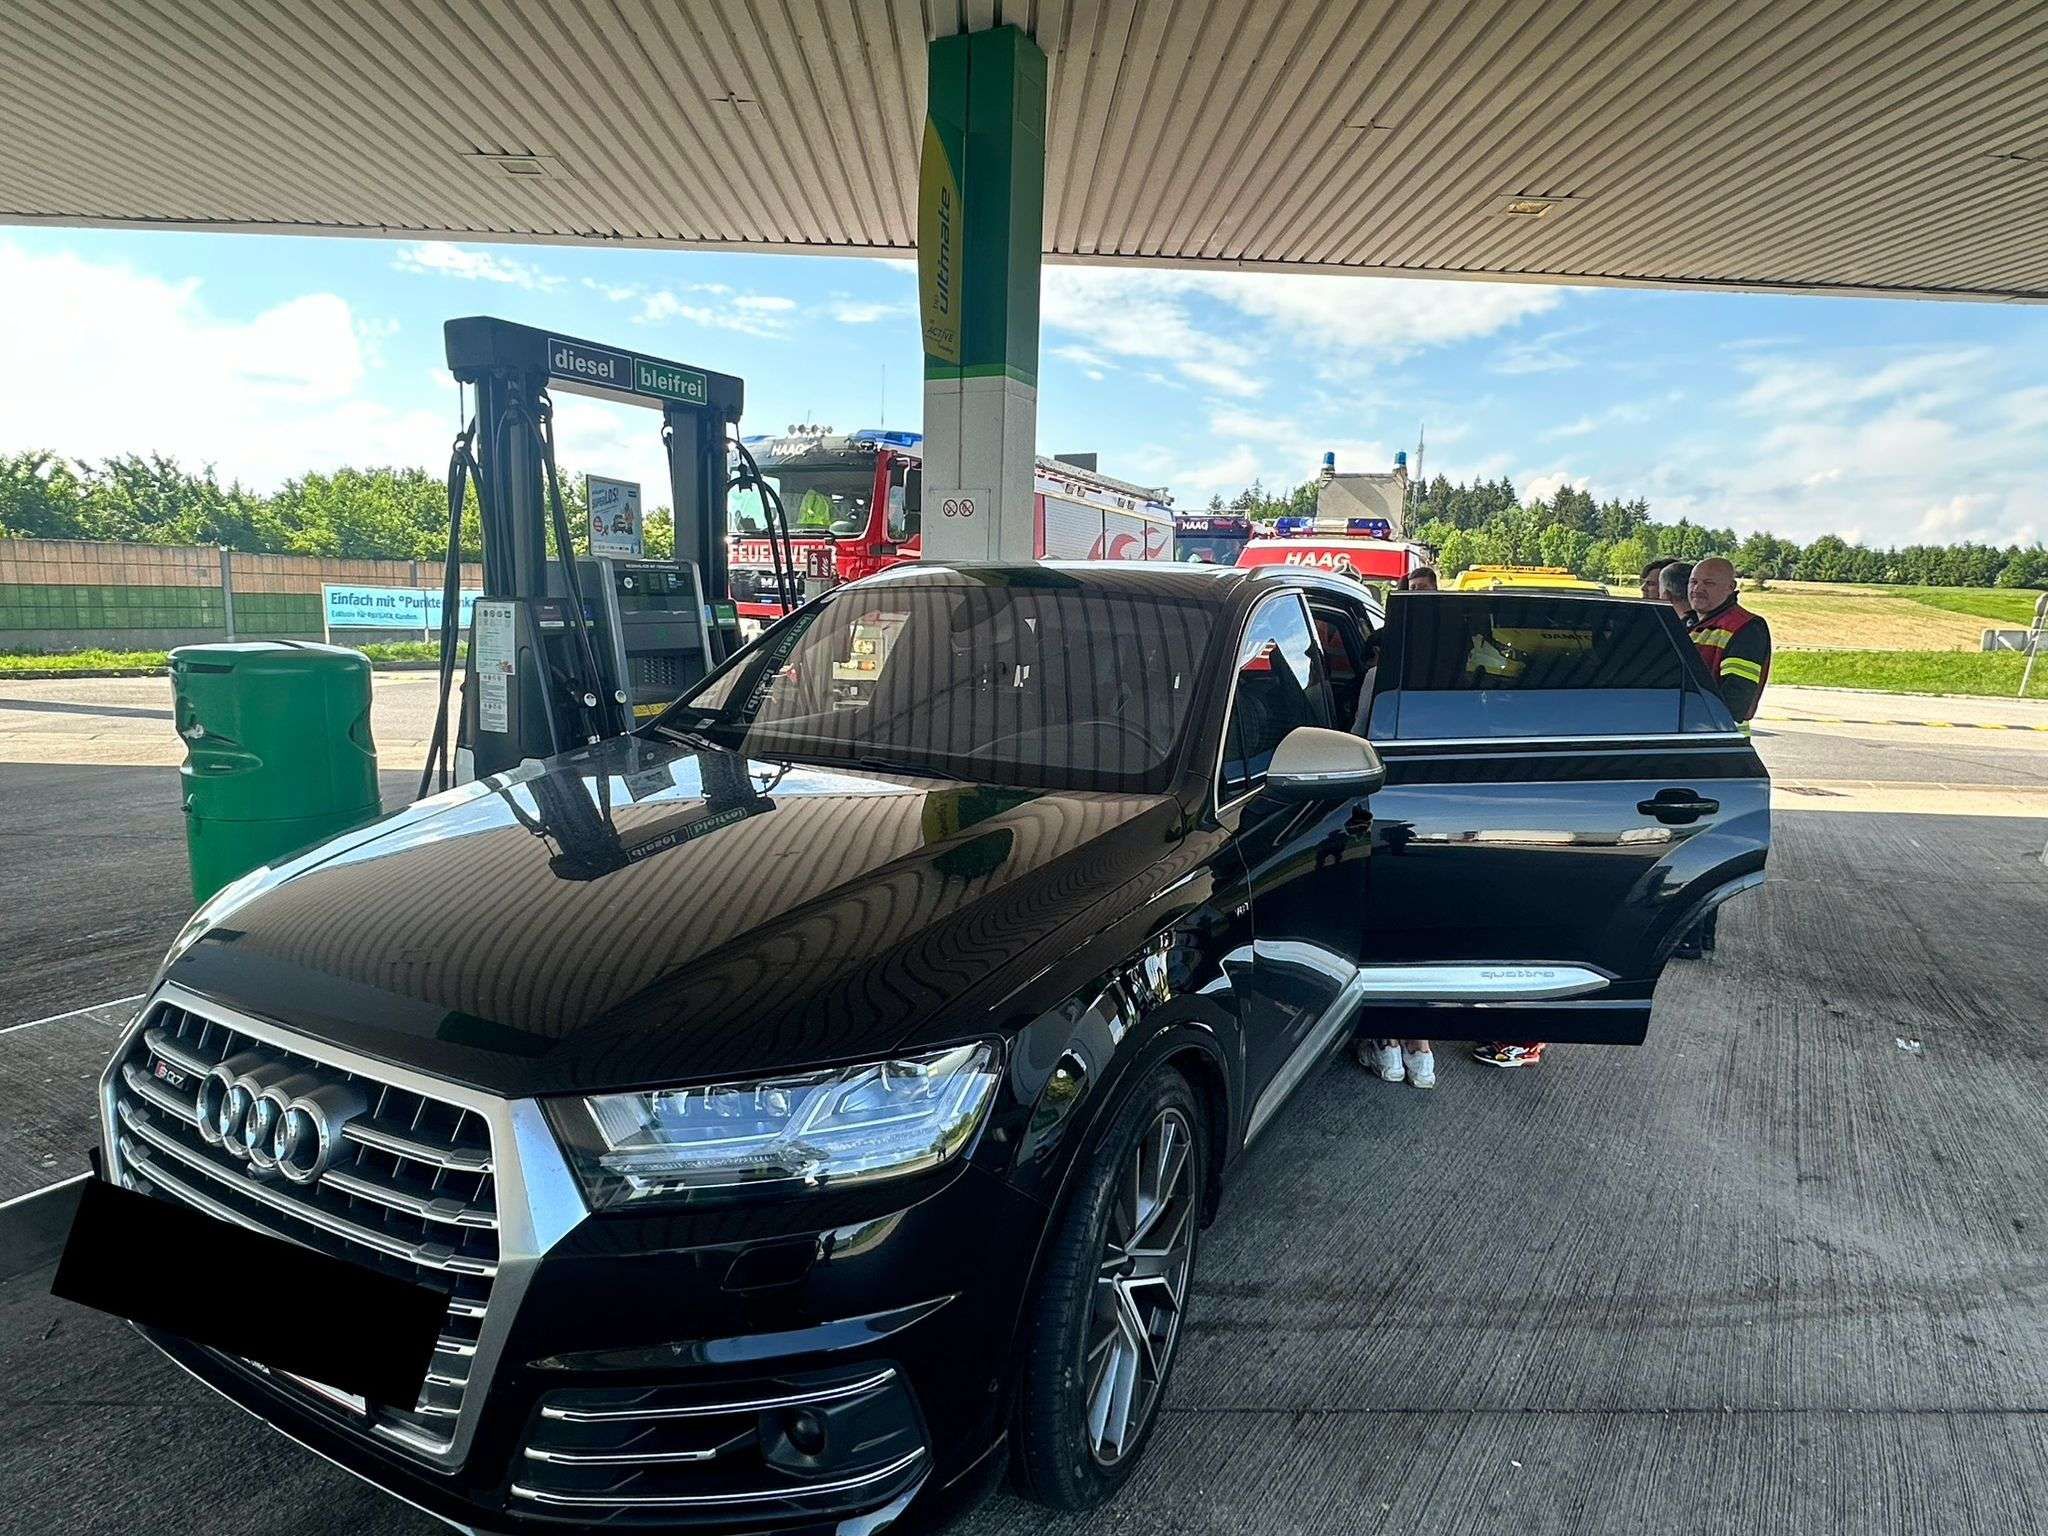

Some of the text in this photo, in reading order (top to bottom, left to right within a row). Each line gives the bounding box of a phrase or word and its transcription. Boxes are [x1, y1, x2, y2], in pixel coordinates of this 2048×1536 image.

[936, 186, 951, 315] ultimate
[555, 349, 614, 378] diesel
[641, 368, 702, 397] bleifrei
[1182, 520, 1209, 531] HAAG
[728, 543, 837, 565] FEUEWER
[1284, 552, 1351, 570] HAAG
[331, 593, 373, 606] Einfach
[376, 596, 396, 608] mit
[1480, 970, 1556, 979] quattro
